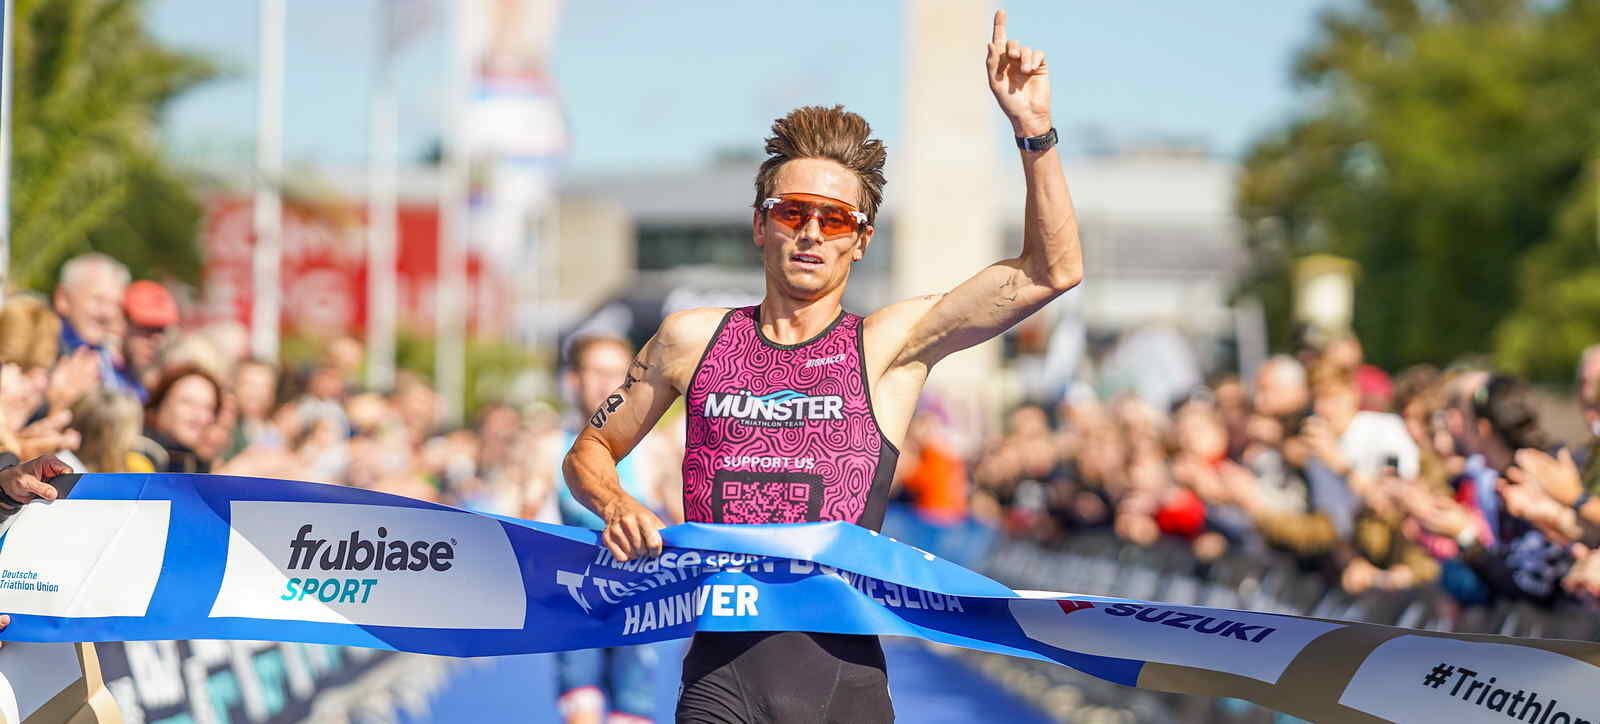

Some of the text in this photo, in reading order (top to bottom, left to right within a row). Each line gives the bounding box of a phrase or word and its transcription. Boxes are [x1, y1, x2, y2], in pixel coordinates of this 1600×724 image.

[704, 390, 844, 421] MÜNSTER
[723, 456, 815, 469] SUPPORT US
[287, 524, 454, 572] frubiase
[2, 569, 38, 580] Deutsche
[37, 581, 59, 592] Union
[281, 578, 378, 604] SPORT
[1104, 603, 1276, 643] SUZUKI
